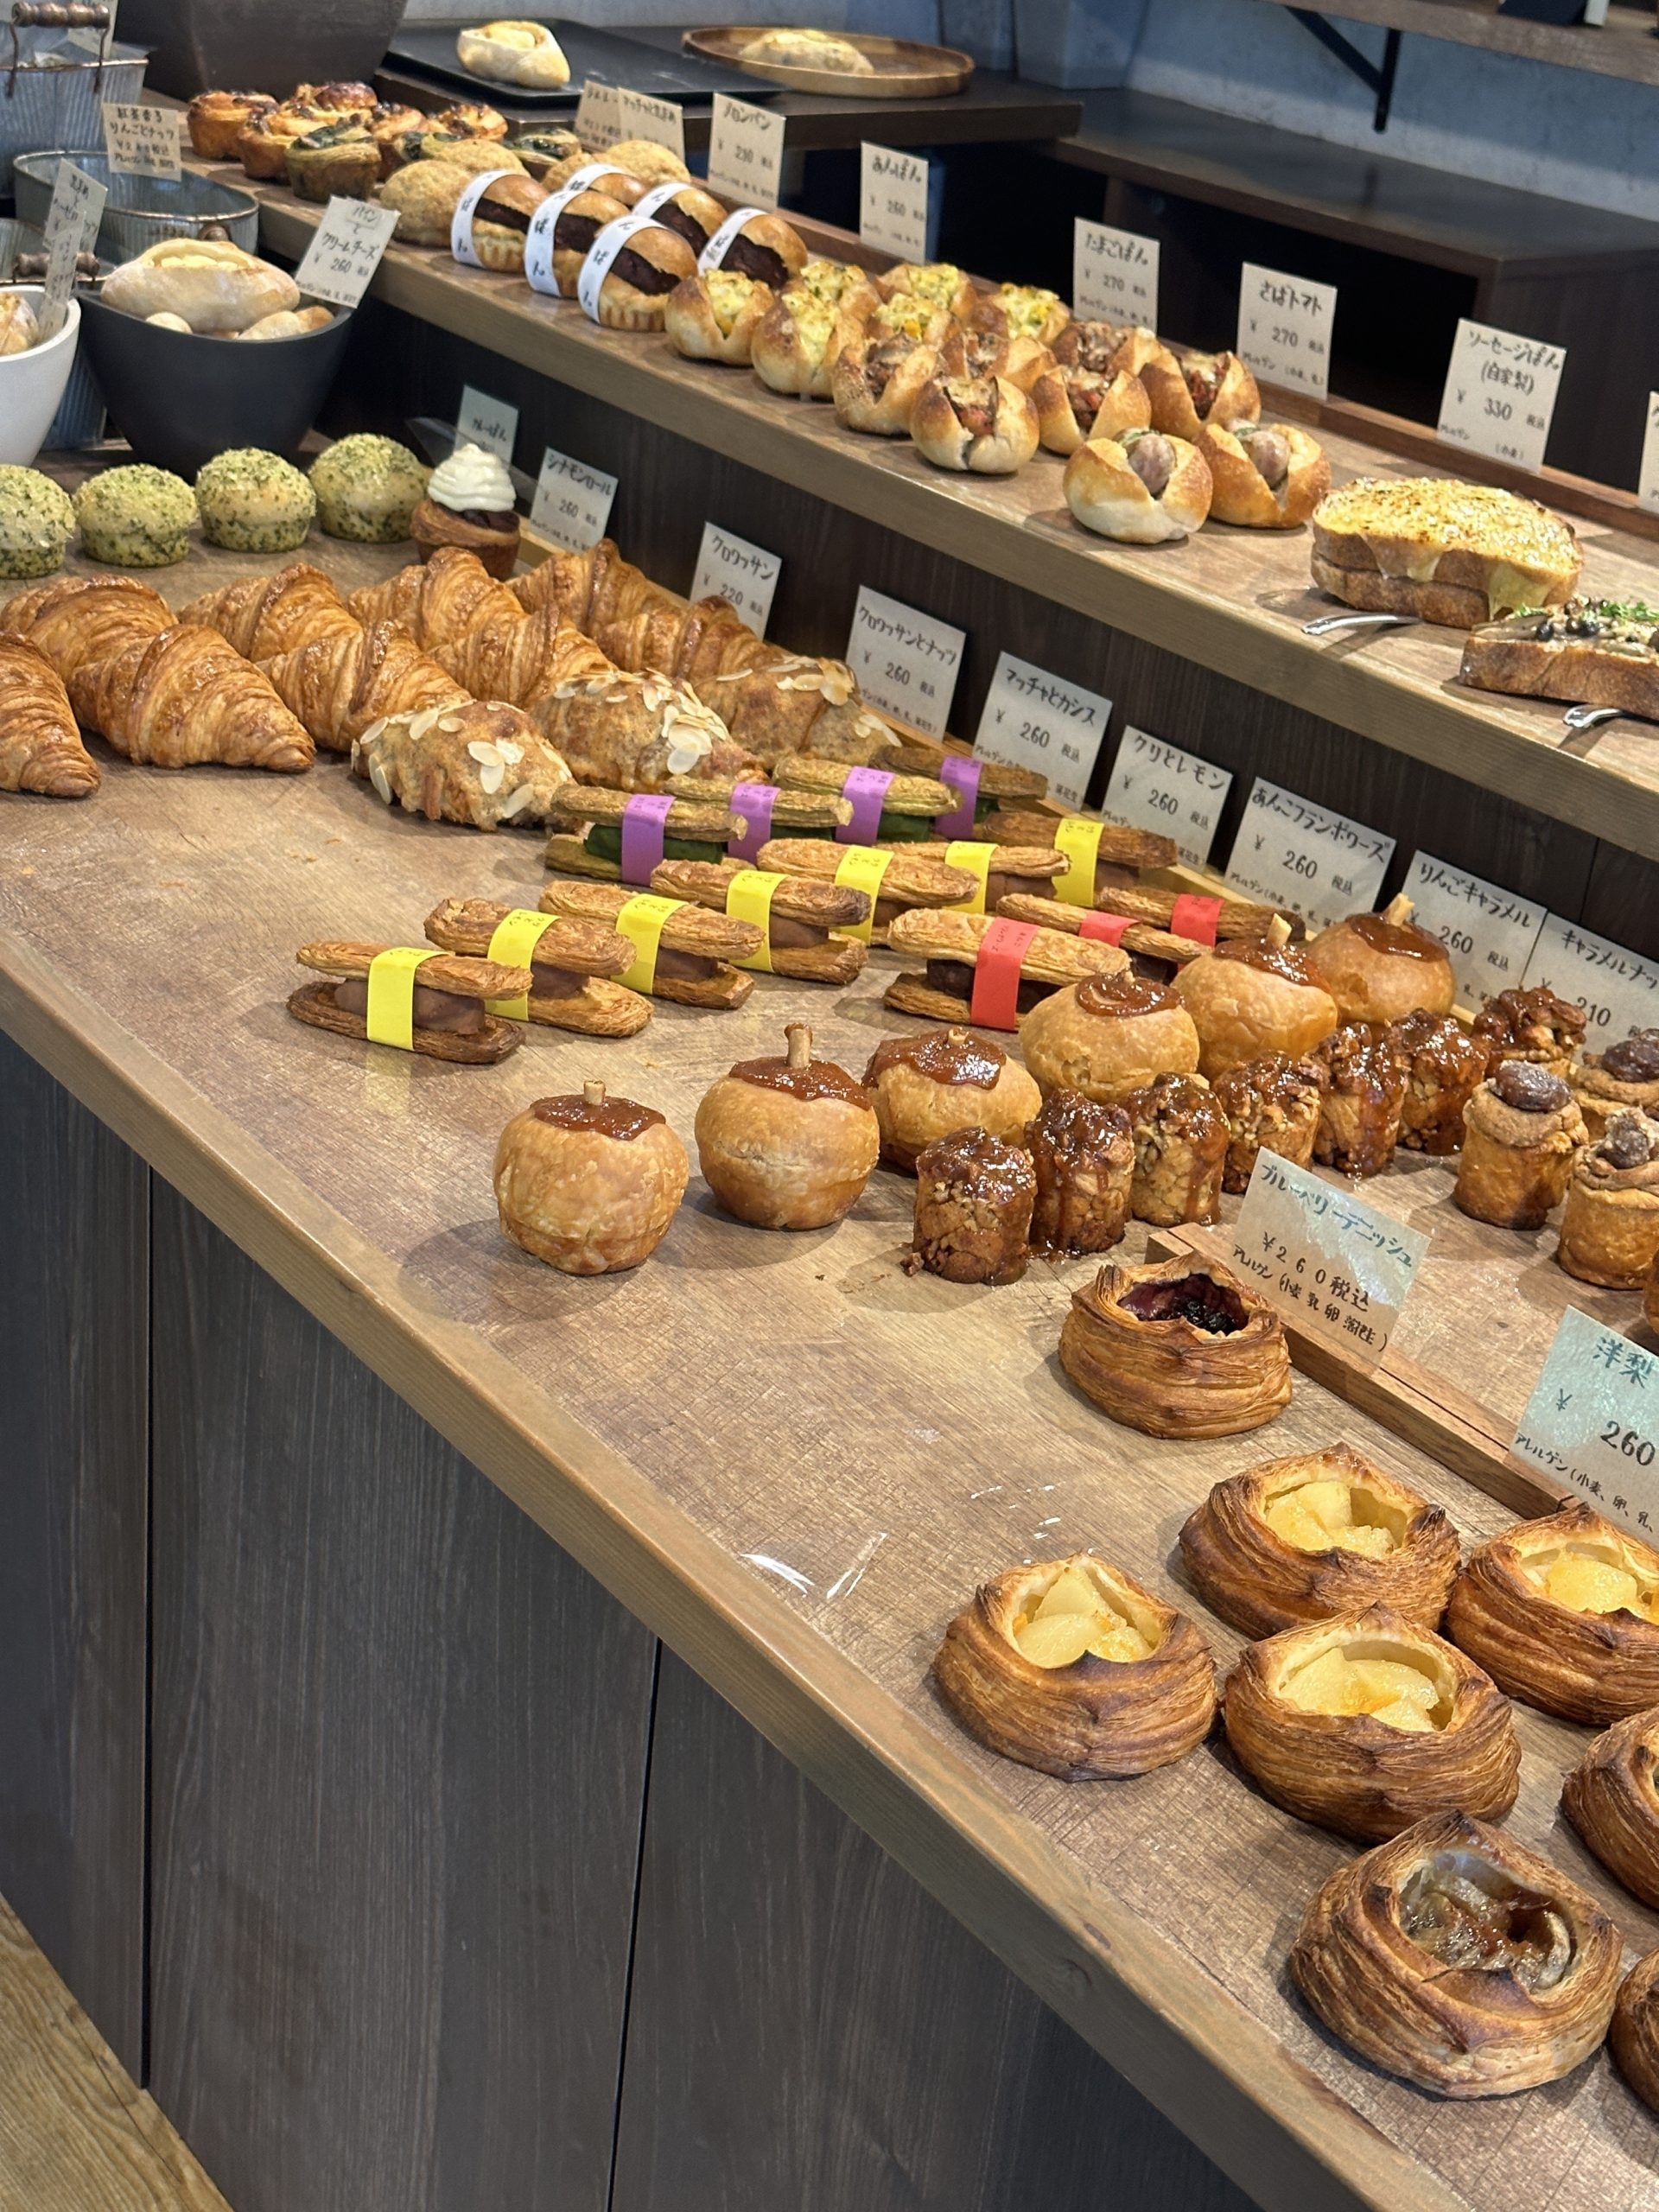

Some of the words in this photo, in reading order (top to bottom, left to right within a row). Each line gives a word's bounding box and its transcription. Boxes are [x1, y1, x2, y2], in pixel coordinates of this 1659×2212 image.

[329, 257, 353, 274] 260
[1259, 279, 1322, 316] さばトマト
[1271, 325, 1299, 347] 270
[1480, 359, 1535, 397] (自家製)
[1484, 396, 1513, 422] 330
[546, 454, 613, 496] シナモンロール
[558, 499, 579, 519] 260
[711, 534, 775, 581] クロワッサン
[719, 583, 744, 607] 220
[858, 606, 957, 666] クロワッサンとナッツ
[885, 661, 911, 686] 260
[1006, 667, 1096, 728] マッチャとカシス
[1019, 721, 1051, 748] 260
[1134, 734, 1225, 791] クリとレモン
[1147, 788, 1179, 816] 260
[1282, 849, 1319, 880] 260
[1420, 862, 1531, 929] りんごキャラメル
[1438, 925, 1474, 955] 260
[1577, 995, 1611, 1027] 210
[1261, 1163, 1413, 1268] ブルーベリーデニッシュ
[1592, 1336, 1655, 1389] 洋梨
[1555, 1387, 1573, 1412] ¥
[1599, 1420, 1656, 1467] 260
